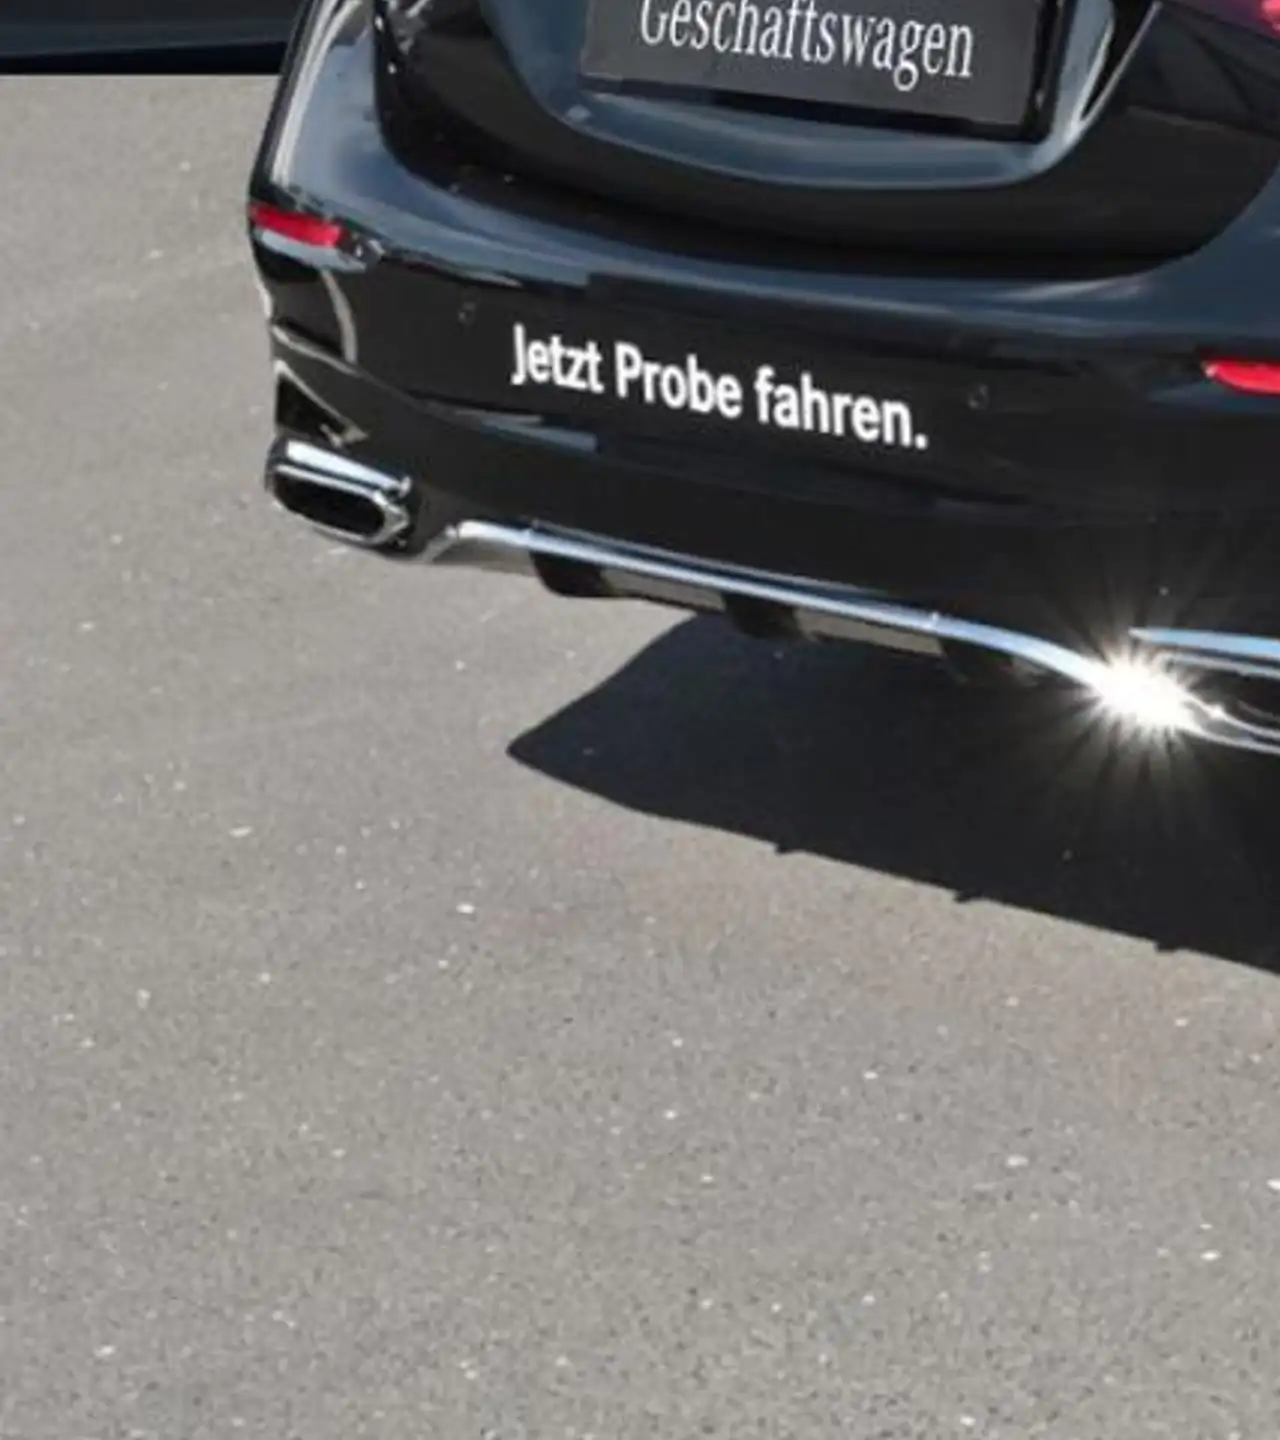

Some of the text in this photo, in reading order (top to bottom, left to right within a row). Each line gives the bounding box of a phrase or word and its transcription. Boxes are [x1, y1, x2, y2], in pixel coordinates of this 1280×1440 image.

[510, 322, 929, 451] Jetzt Probe fahren.
